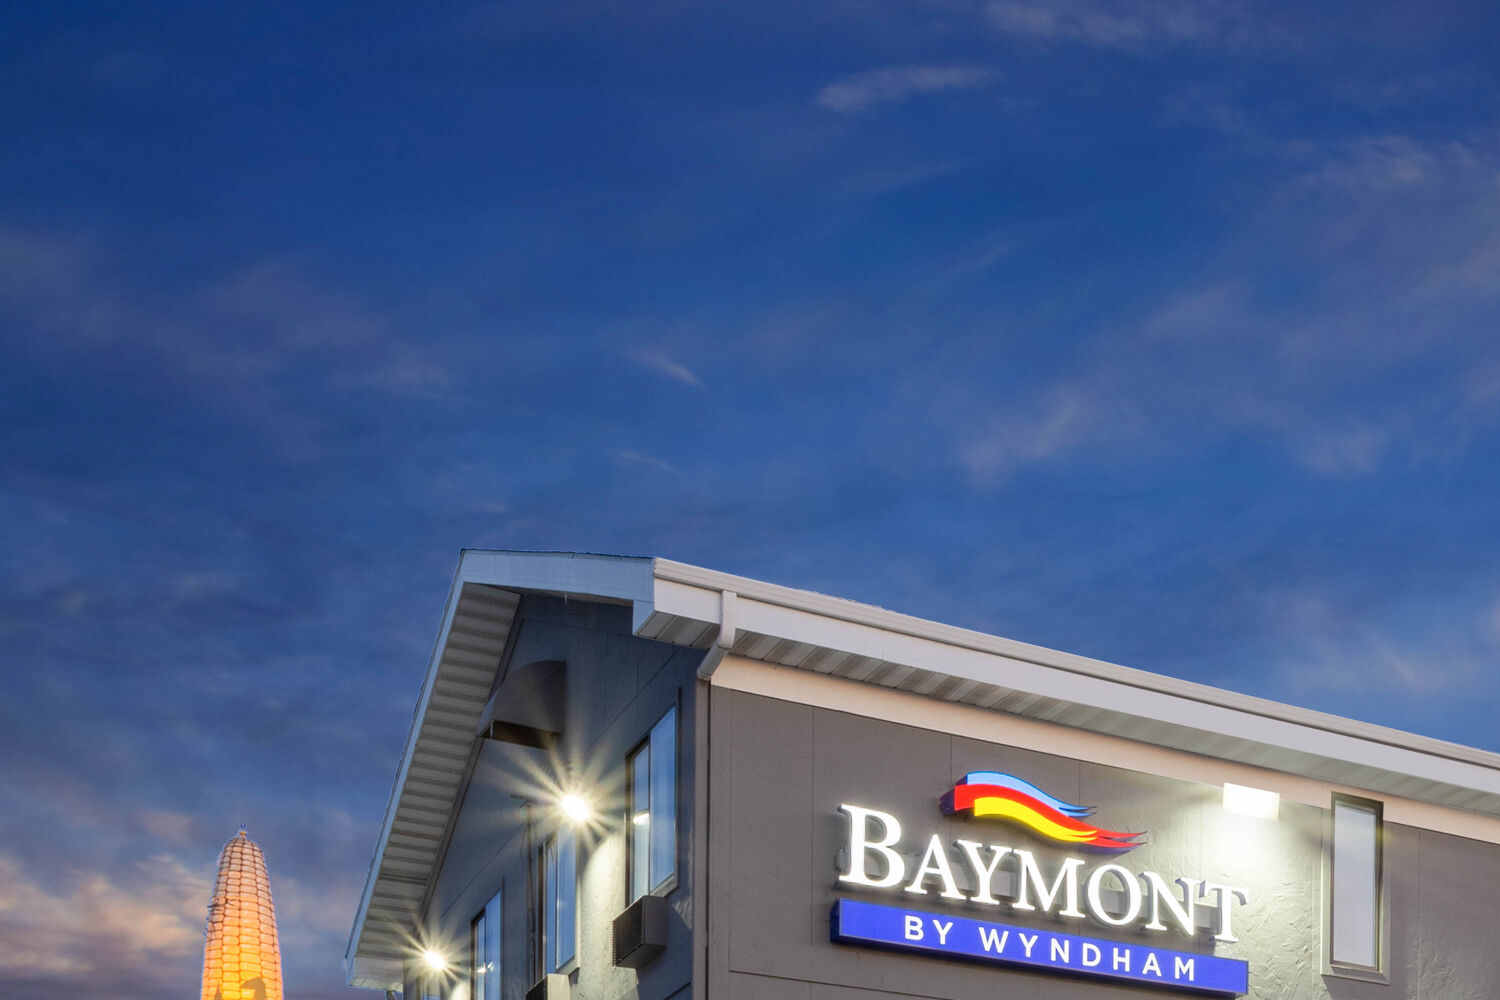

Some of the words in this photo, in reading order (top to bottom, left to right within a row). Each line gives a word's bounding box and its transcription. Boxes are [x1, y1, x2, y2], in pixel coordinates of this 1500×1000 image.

[839, 803, 1249, 942] BAYMONT
[904, 914, 954, 945] BY
[978, 926, 1195, 982] WYNDHAM
